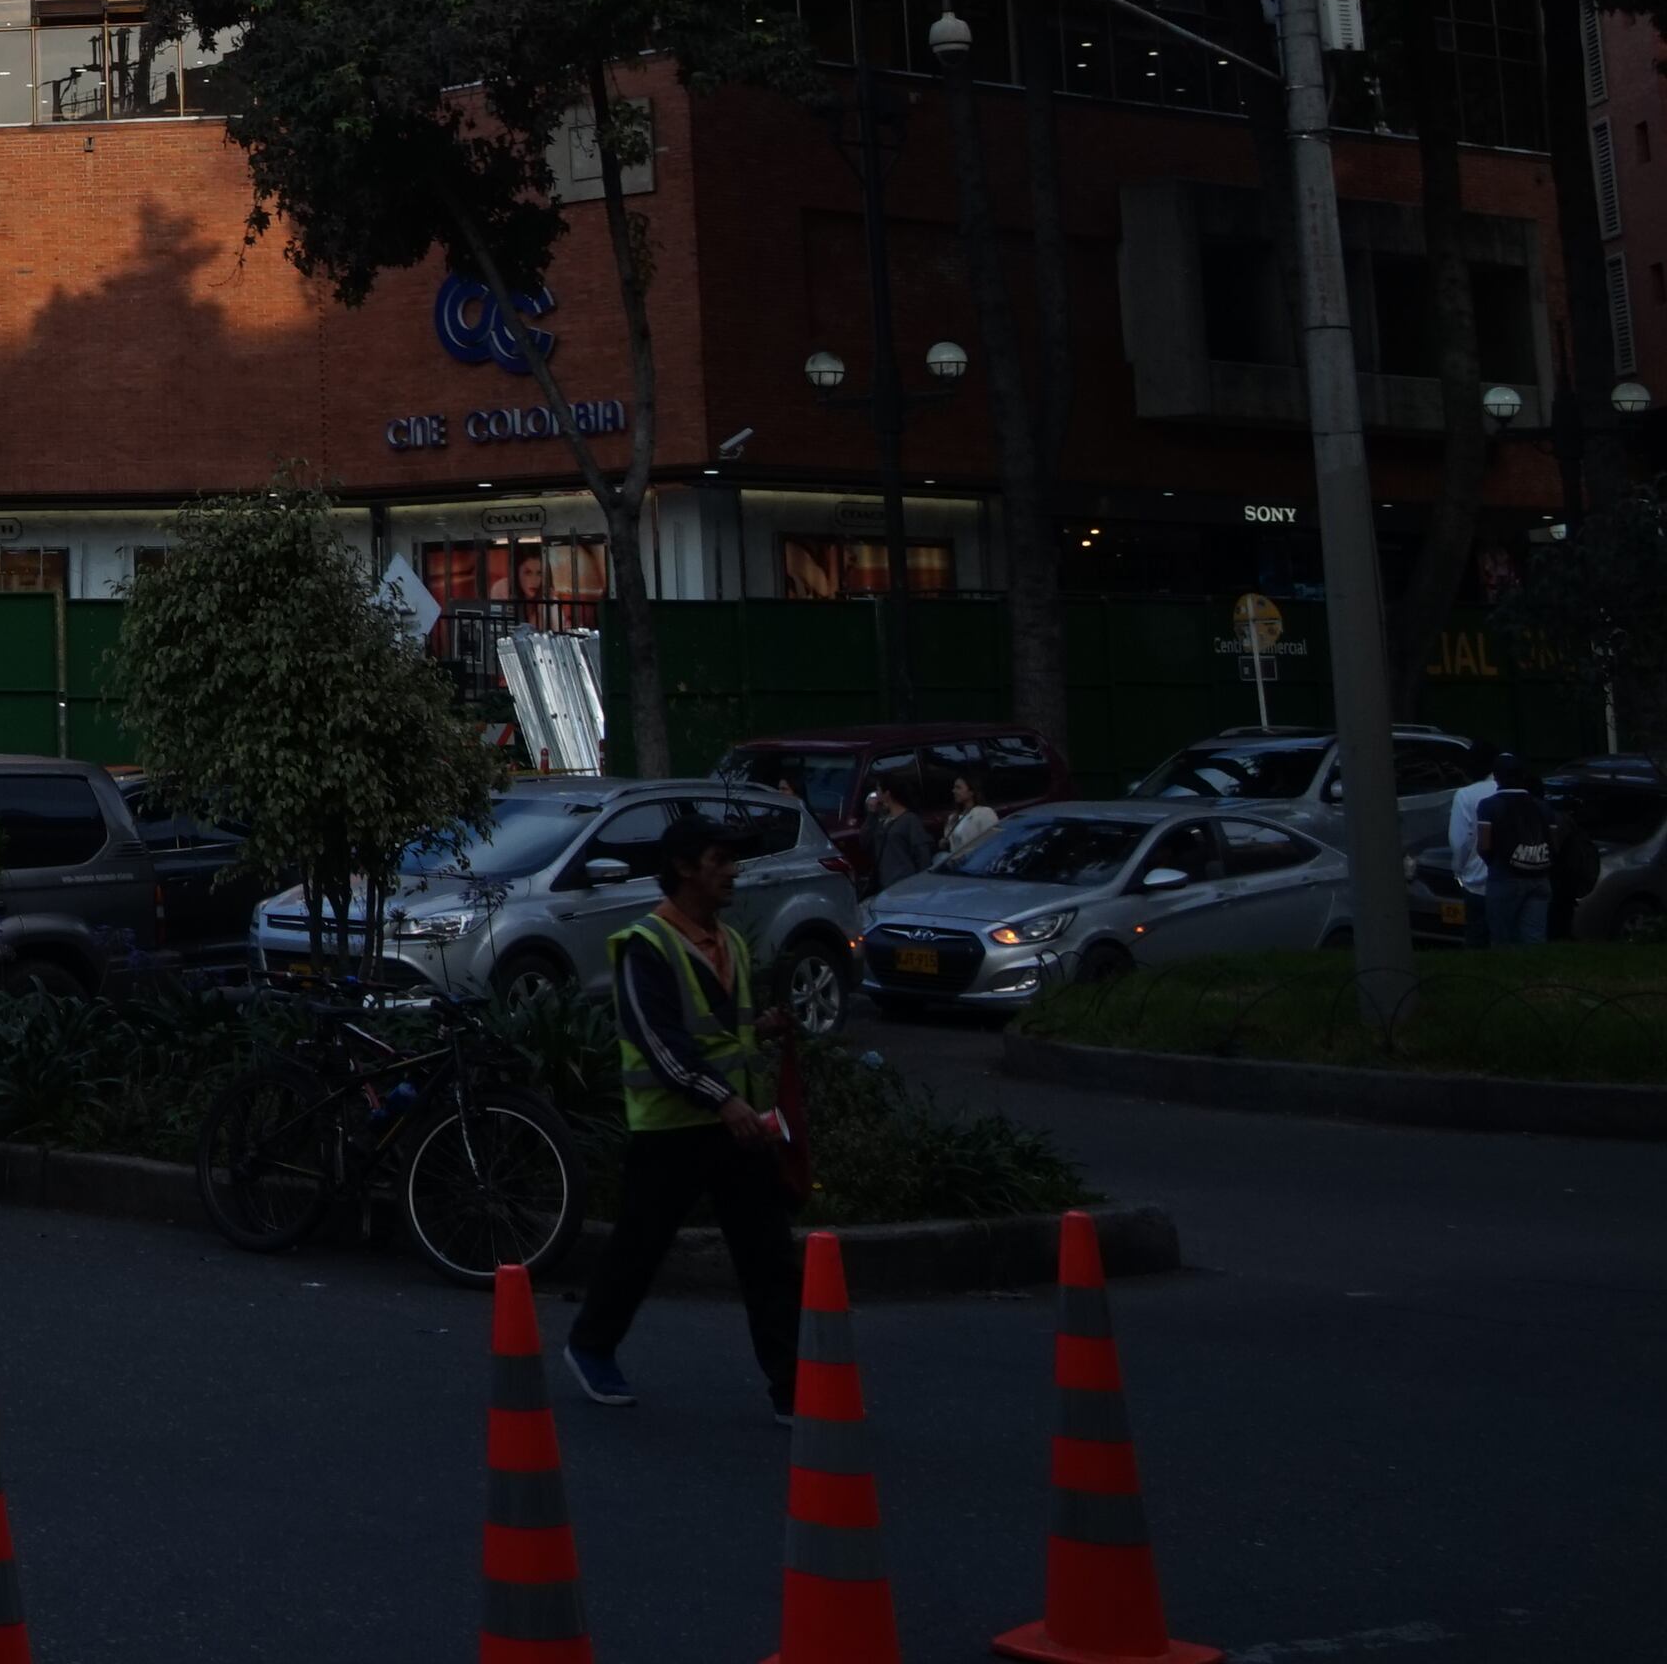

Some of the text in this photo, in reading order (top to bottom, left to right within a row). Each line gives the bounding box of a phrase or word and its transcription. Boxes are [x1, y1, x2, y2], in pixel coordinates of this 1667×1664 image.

[386, 415, 449, 451] CINE
[486, 512, 541, 525] COACH
[1243, 505, 1298, 523] SONY
[1509, 842, 1551, 865] NIKE
